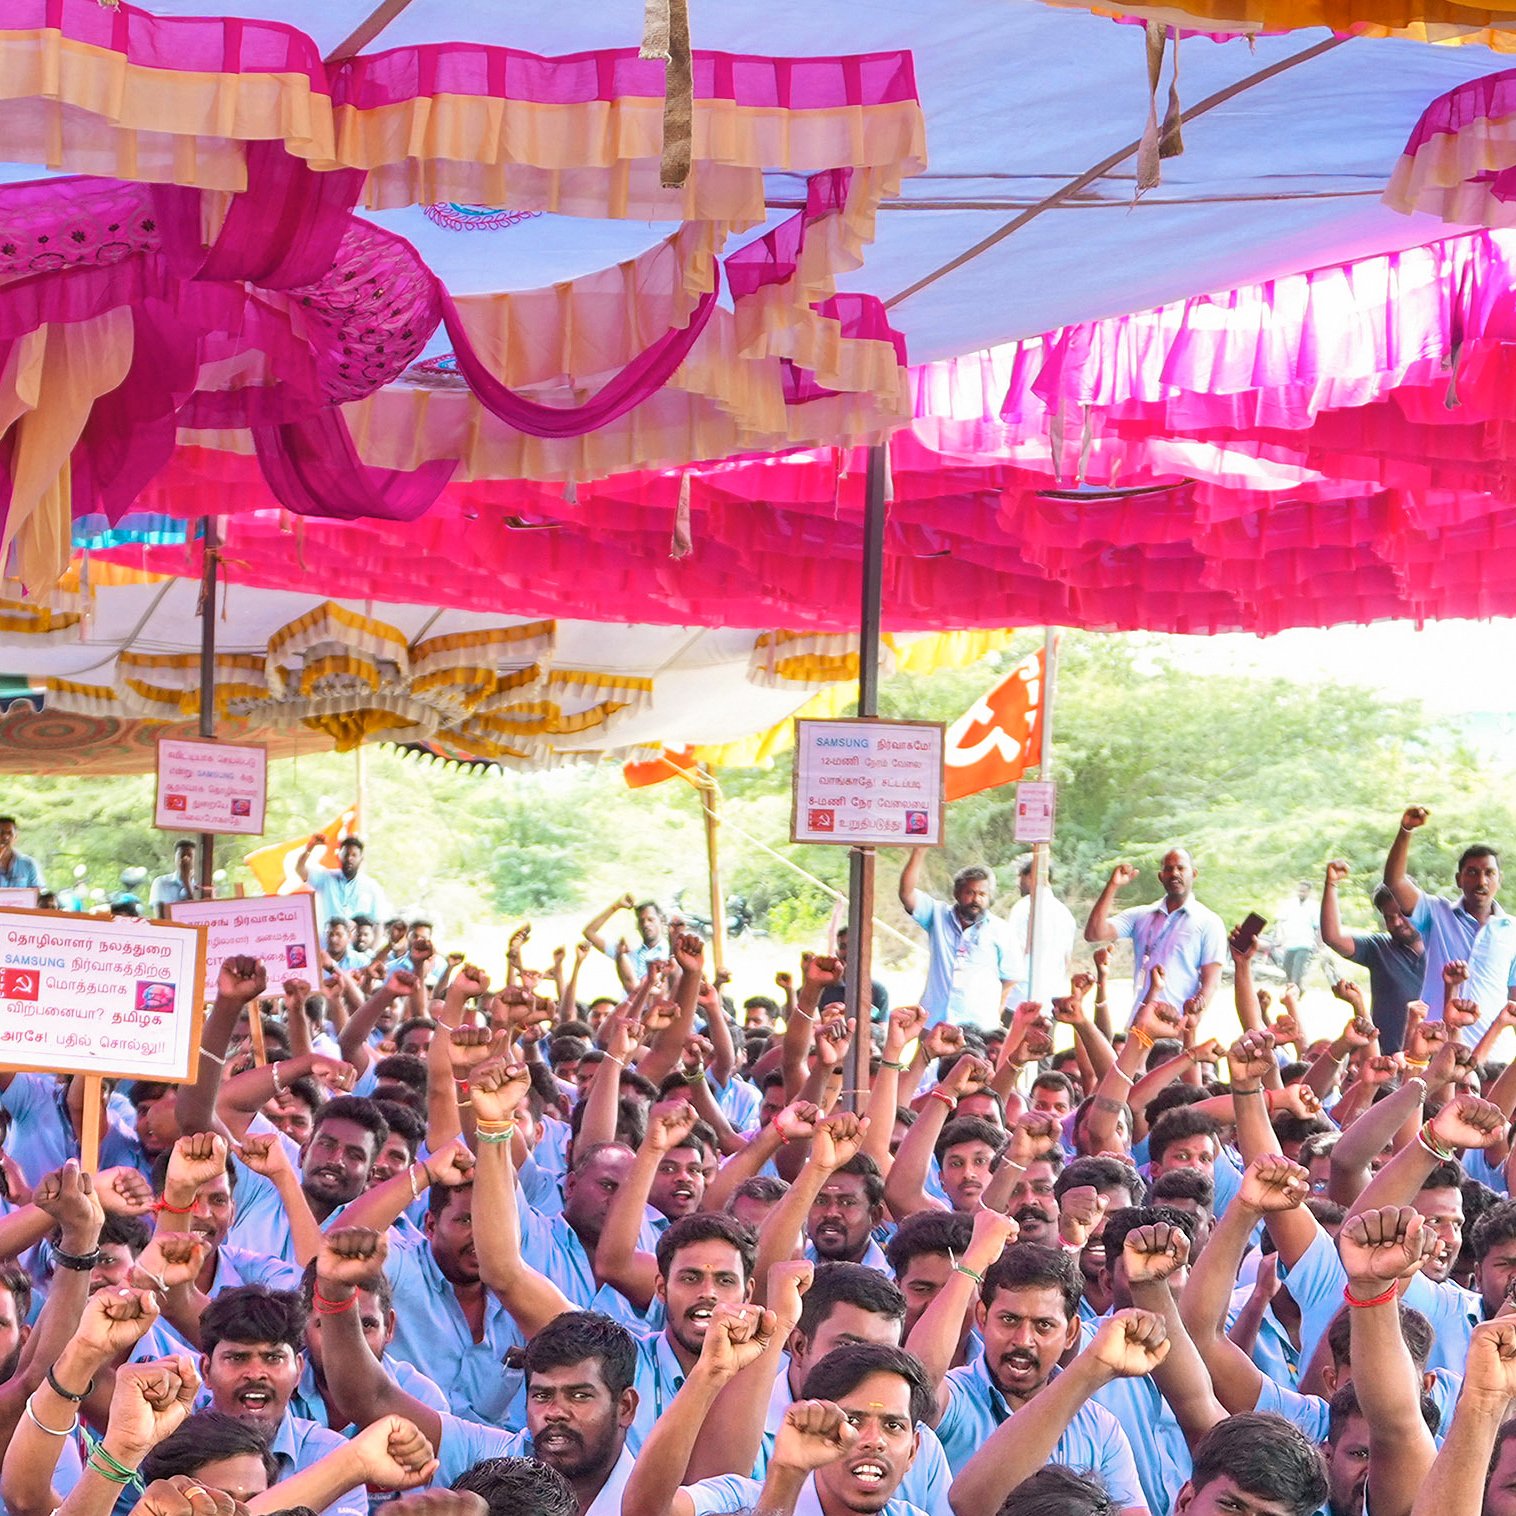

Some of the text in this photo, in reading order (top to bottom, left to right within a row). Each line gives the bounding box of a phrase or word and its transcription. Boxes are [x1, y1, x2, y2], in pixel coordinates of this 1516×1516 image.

[816, 737, 869, 749] SAMSUNG
[7, 930, 172, 958] தொழிலாளர் நலத்துறை
[5, 953, 172, 979] SAMSUNG நிர்வாகத்திற்கு
[206, 956, 227, 966] CIT
[45, 976, 128, 995] மொத்தமாக
[6, 1001, 163, 1028] விற்பனையா? தமிழக
[56, 1031, 93, 1049] பதில்
[99, 1036, 166, 1056] சொல்லு!!
